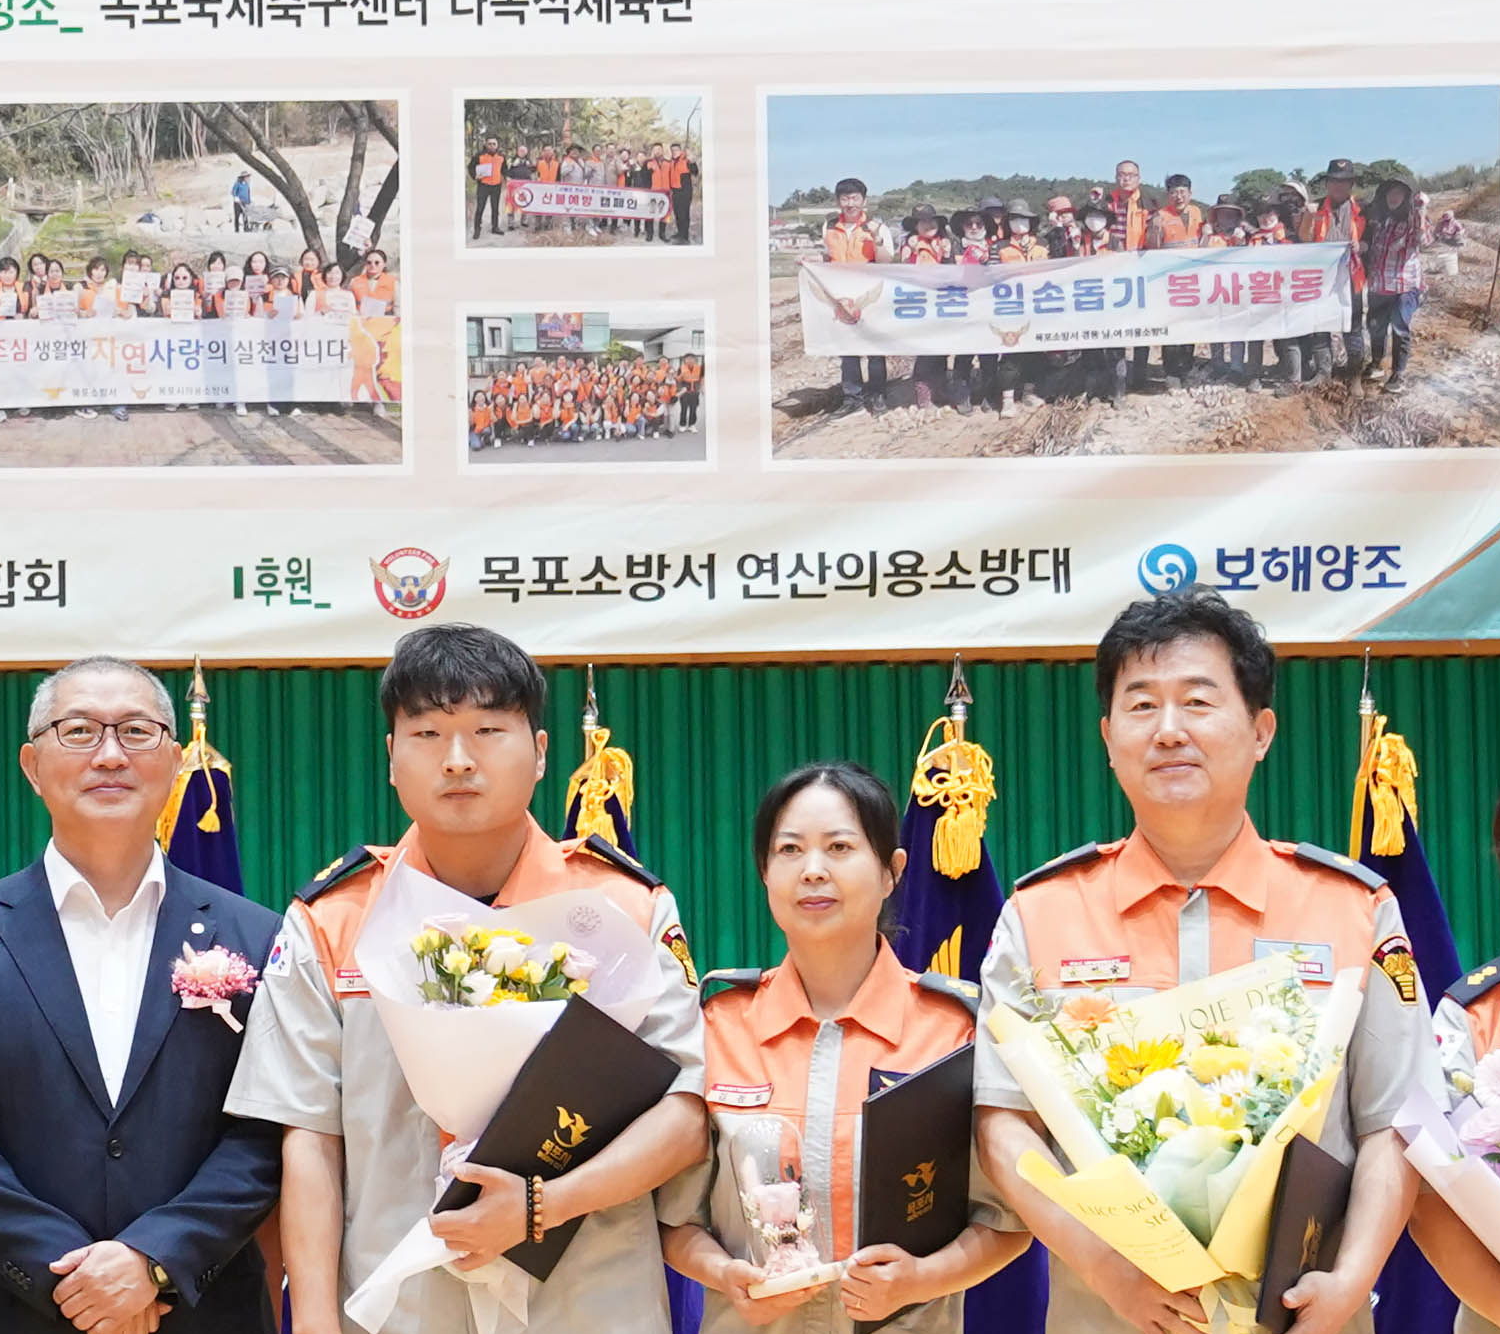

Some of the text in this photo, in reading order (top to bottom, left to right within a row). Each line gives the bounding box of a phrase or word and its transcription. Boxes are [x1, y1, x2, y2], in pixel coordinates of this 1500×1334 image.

[892, 269, 1326, 320] 농촌 일손돕기 봉사활동
[33, 339, 88, 363] 생활화
[90, 334, 228, 375] 자연사랑의
[478, 547, 1073, 605] 목포소방서 연산의용소방대
[1214, 544, 1408, 592] 보해양조
